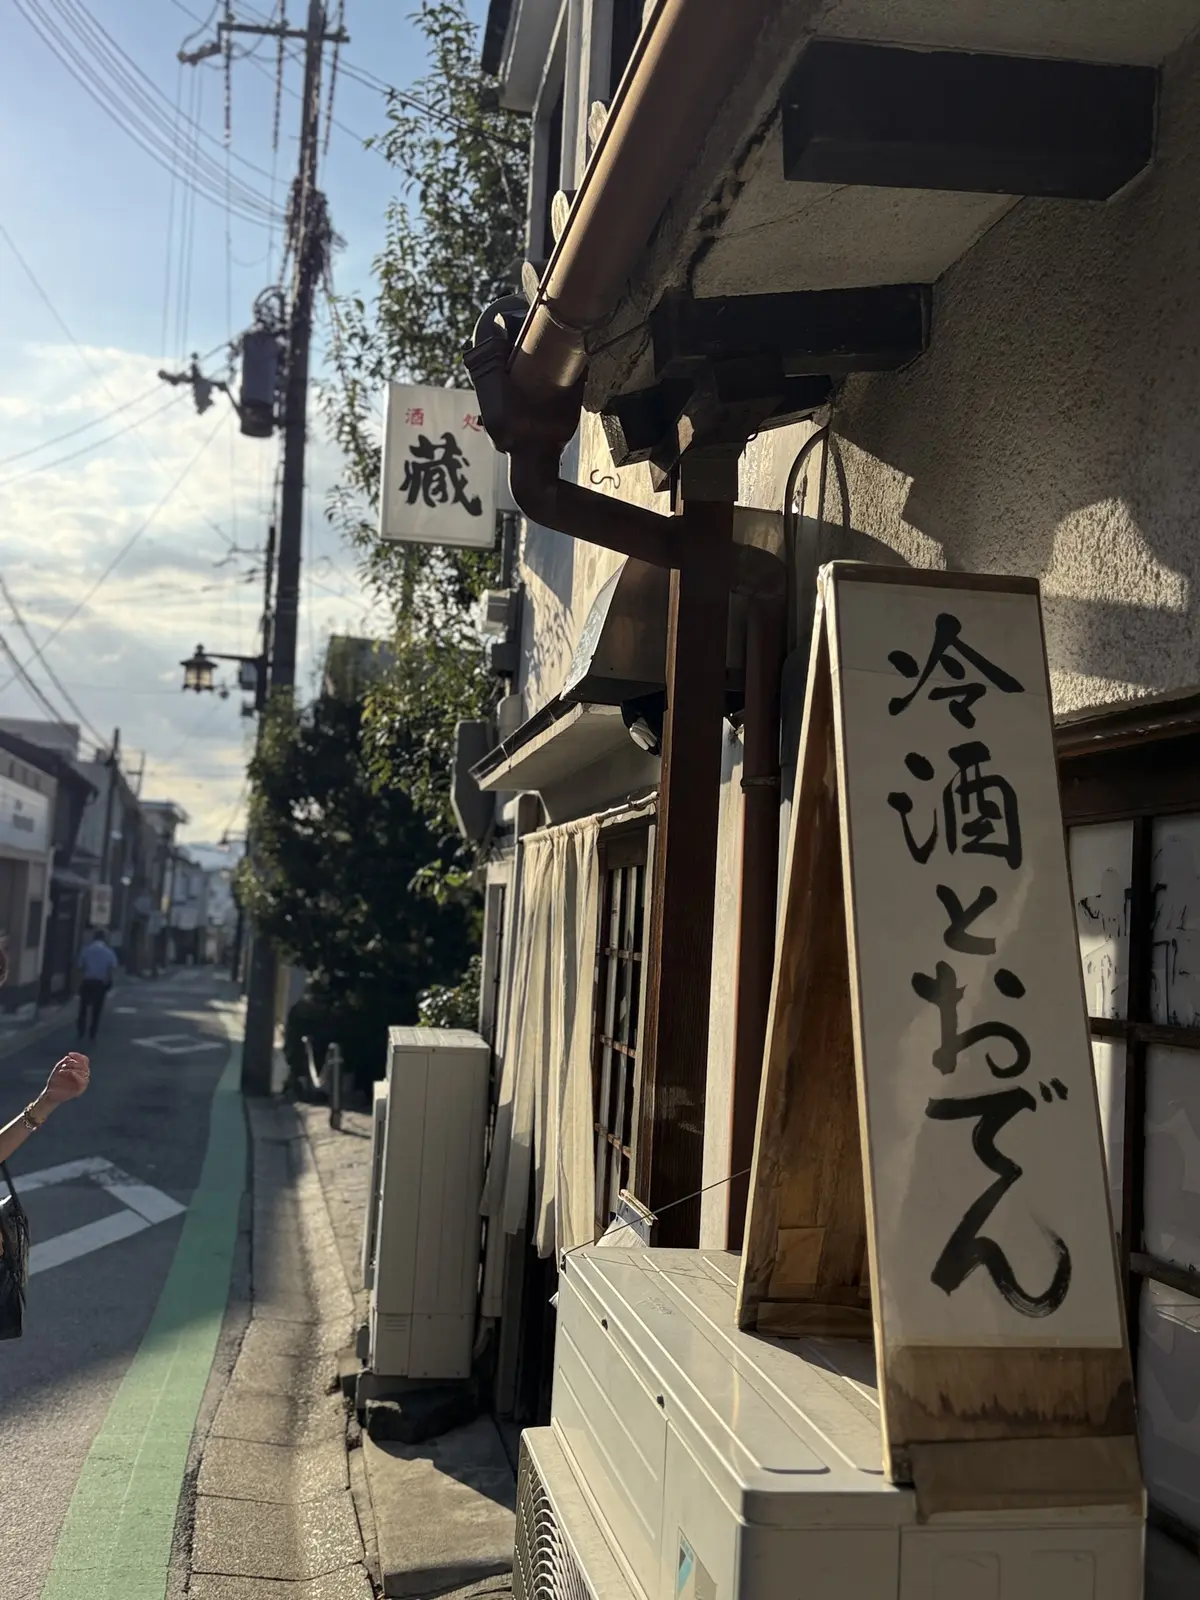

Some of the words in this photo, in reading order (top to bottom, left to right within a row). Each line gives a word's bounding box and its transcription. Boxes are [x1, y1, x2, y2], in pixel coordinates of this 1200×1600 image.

[887, 612, 1072, 1318] 冷酒とおでん
